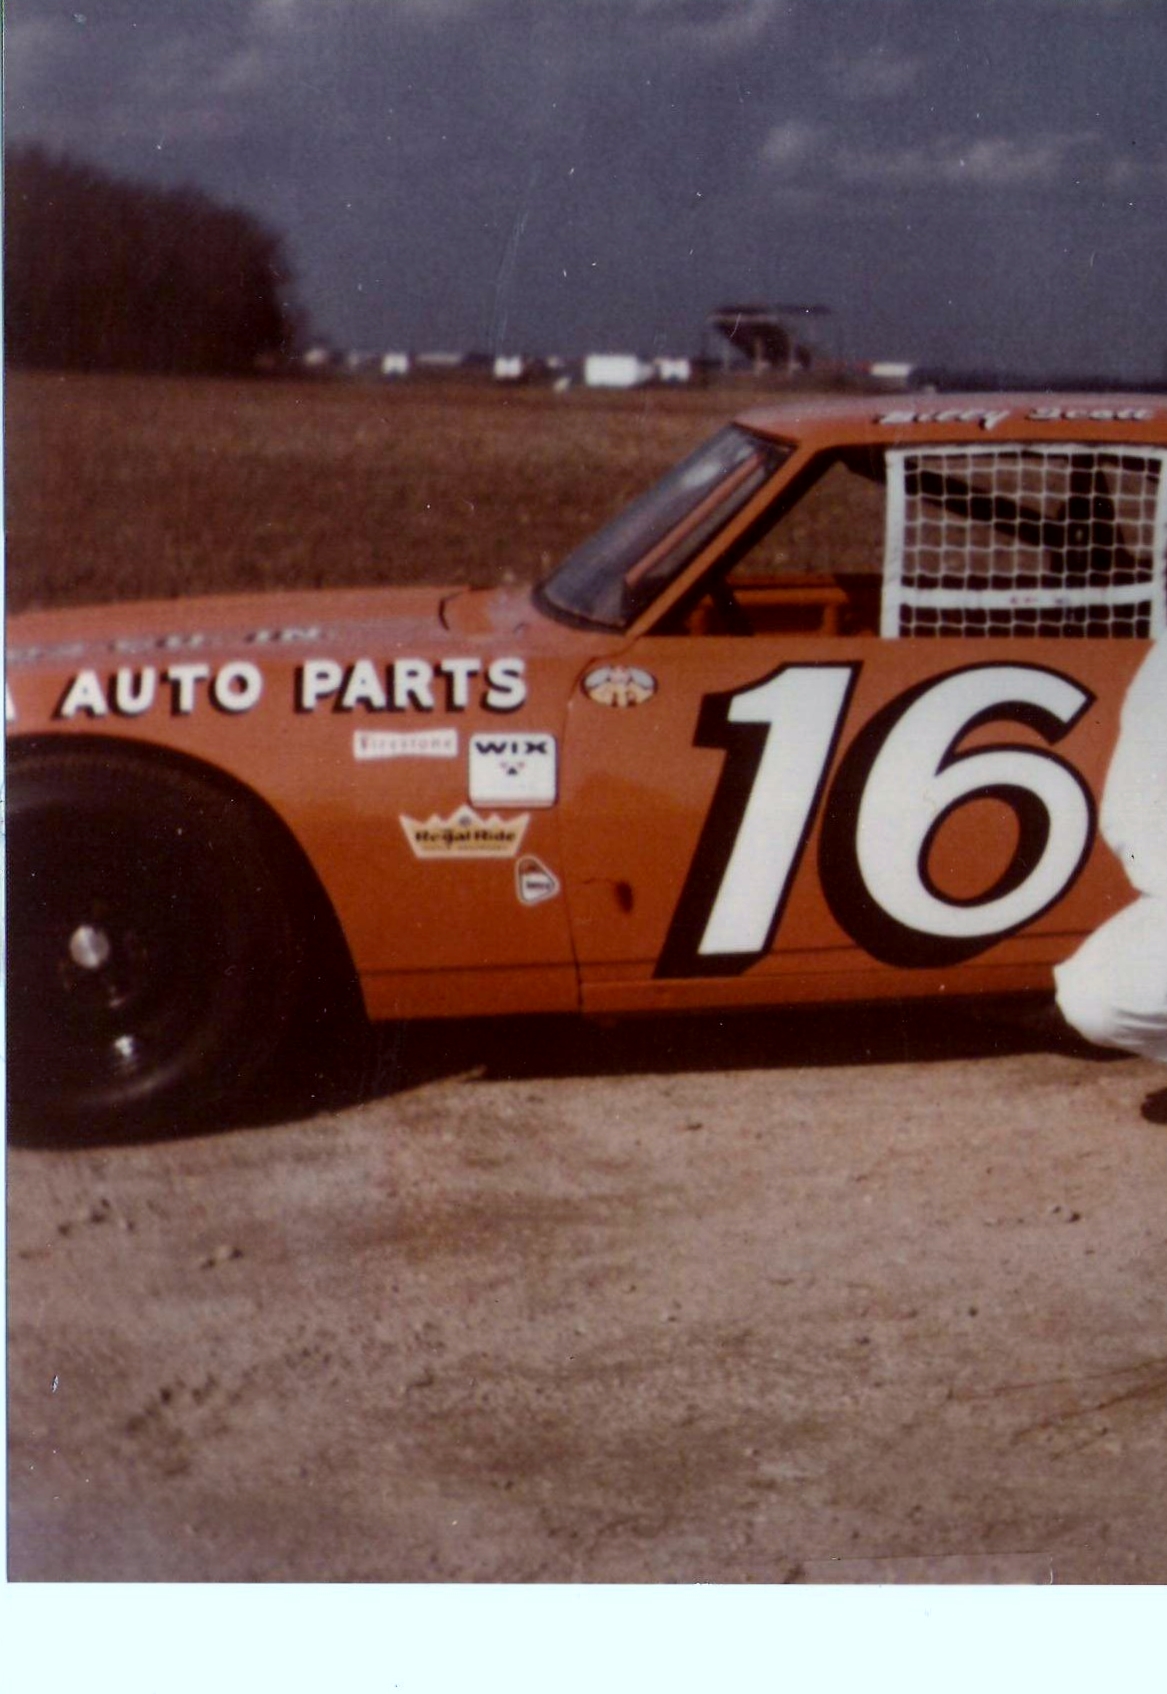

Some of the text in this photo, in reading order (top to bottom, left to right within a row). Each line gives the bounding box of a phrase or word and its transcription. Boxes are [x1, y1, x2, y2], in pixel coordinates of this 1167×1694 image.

[57, 660, 264, 720] AUTO
[300, 656, 528, 712] PARTS
[475, 740, 547, 754] WIX
[667, 661, 1096, 970] 16
